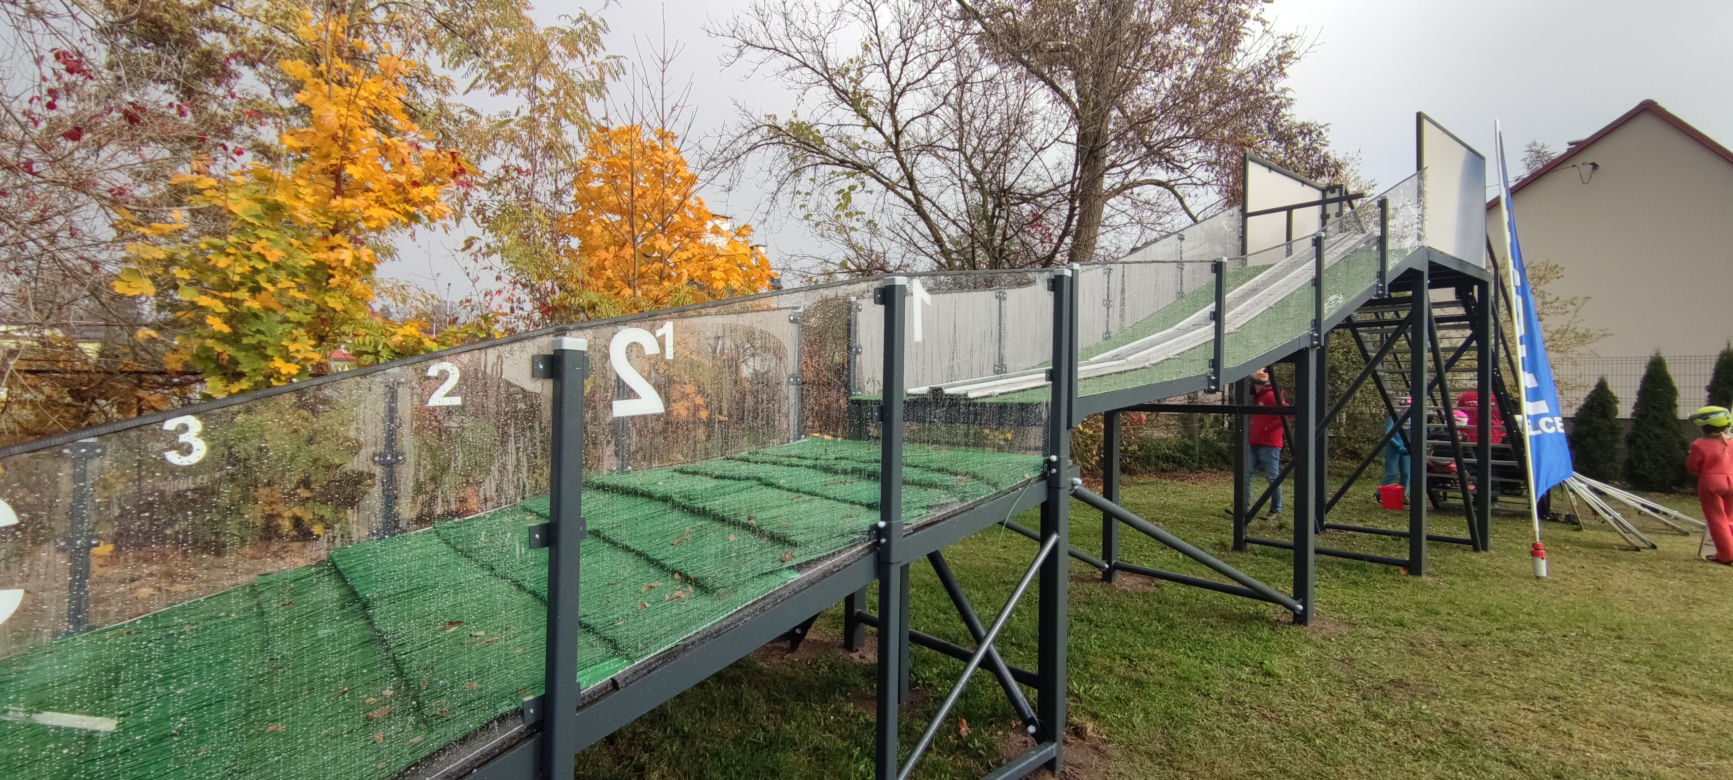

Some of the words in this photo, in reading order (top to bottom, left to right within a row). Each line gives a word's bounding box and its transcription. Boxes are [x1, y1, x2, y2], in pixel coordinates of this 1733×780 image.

[656, 321, 674, 360] 1
[427, 362, 462, 407] 2
[162, 415, 207, 466] 3
